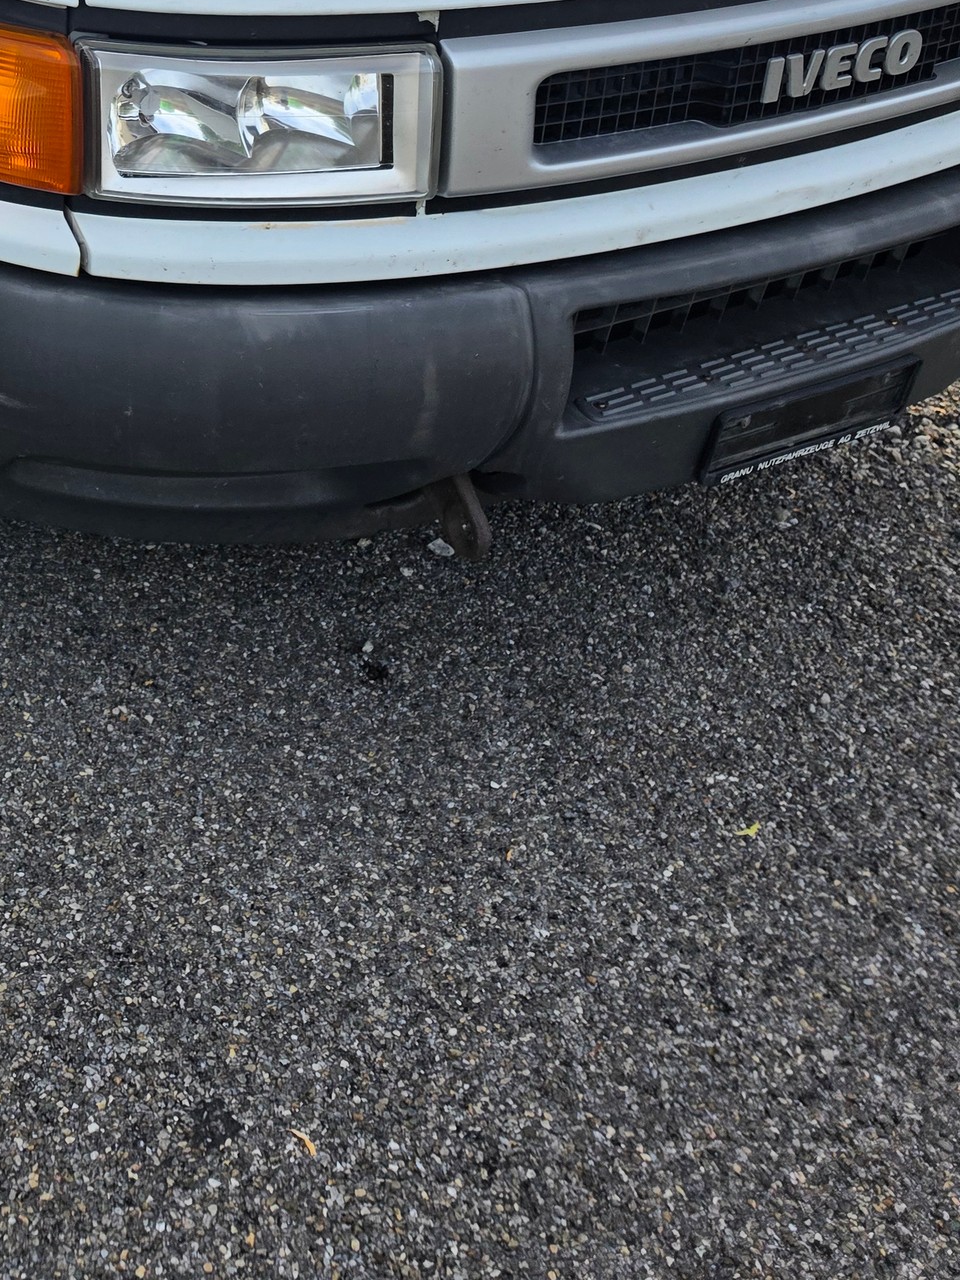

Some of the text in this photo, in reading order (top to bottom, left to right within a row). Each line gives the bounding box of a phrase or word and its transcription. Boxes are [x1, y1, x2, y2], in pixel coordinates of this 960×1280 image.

[759, 28, 923, 104] IVECO
[720, 421, 891, 484] GRANU NUTZFAHRZEUGE AG ZETZWIL
